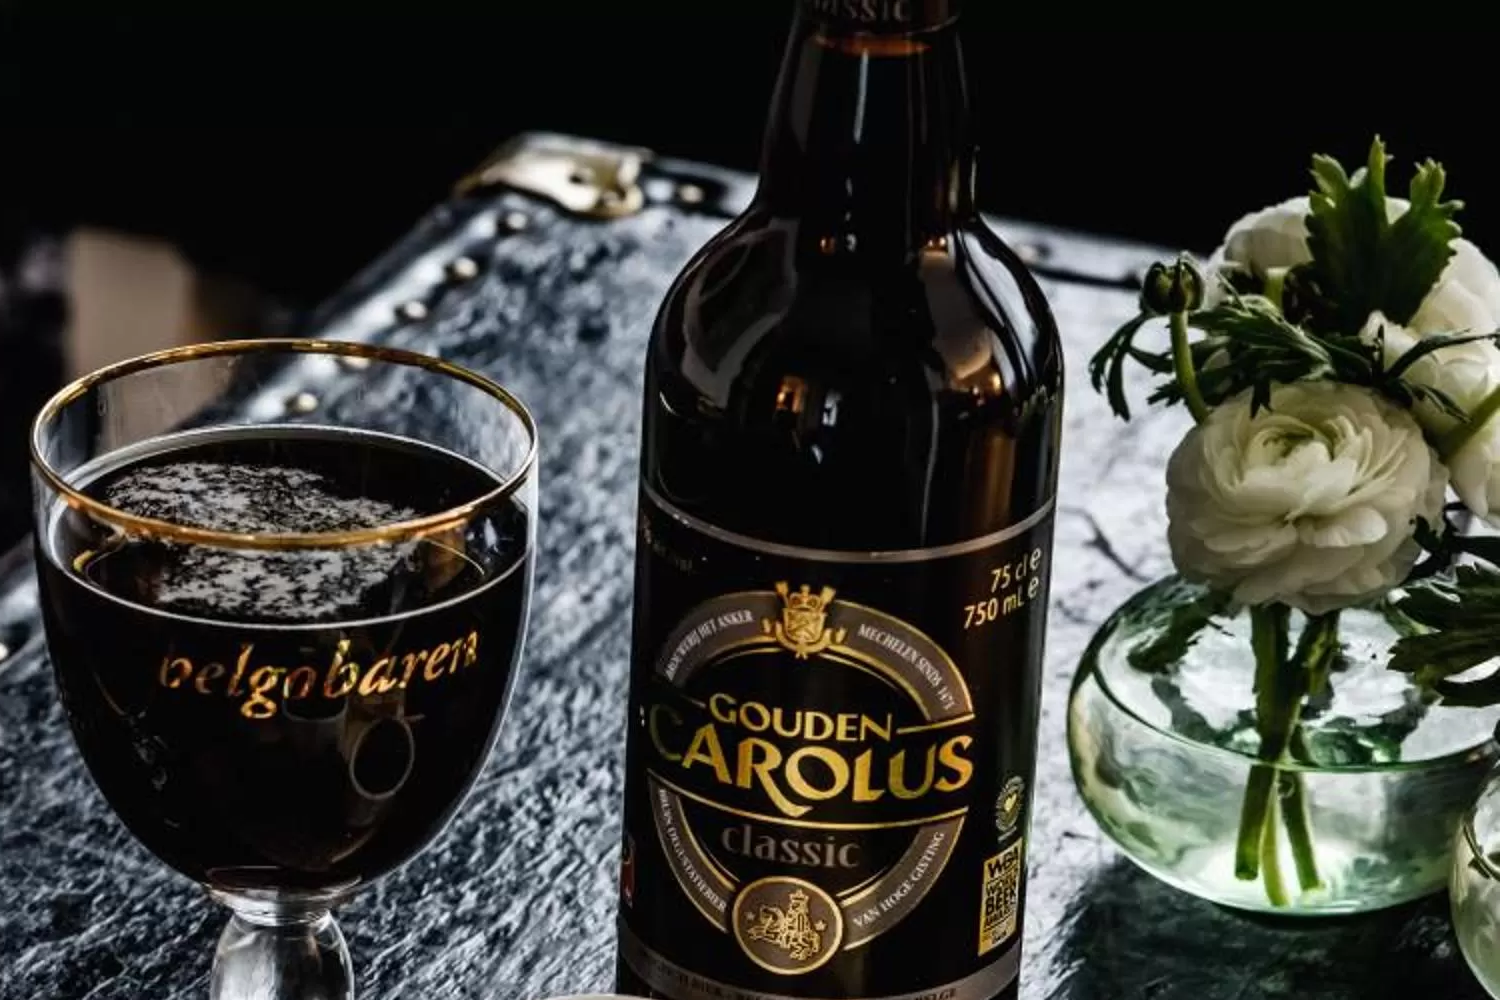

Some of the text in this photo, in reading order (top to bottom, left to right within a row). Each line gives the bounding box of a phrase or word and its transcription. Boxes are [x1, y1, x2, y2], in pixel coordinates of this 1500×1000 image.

[990, 562, 1012, 593] 75
[963, 597, 999, 630] 750
[857, 623, 919, 665] MECHELEN
[158, 626, 482, 722] belgobaren
[708, 692, 893, 742] GOUDEN
[648, 702, 974, 818] CAROLUS
[721, 823, 861, 869] classic
[851, 831, 946, 928] VAN HOGE GISTING
